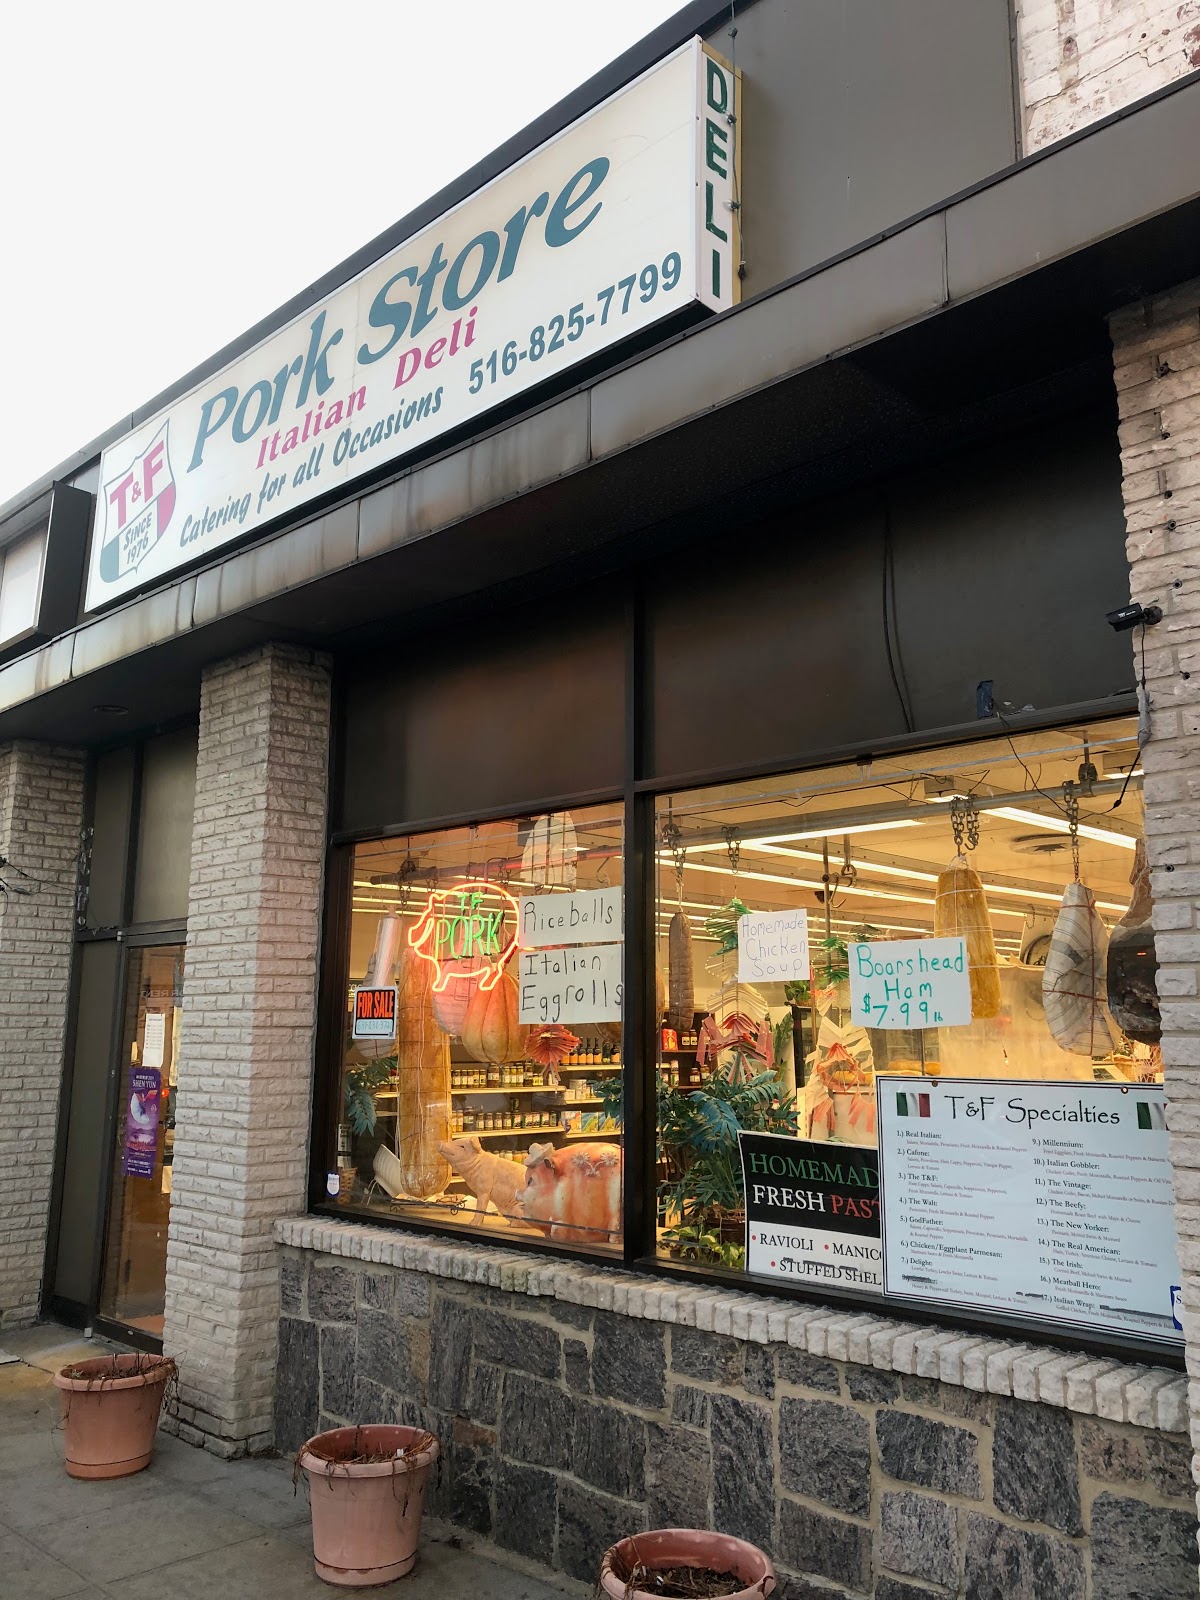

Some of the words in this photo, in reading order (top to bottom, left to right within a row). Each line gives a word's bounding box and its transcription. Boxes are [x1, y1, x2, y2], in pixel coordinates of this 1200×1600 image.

[706, 56, 728, 299] DELI
[187, 309, 343, 474] Pork
[357, 156, 610, 365] Store
[468, 251, 682, 395] 516-825-7799
[255, 385, 367, 470] Italian
[393, 306, 478, 391] Deli
[180, 492, 251, 547] Catering
[256, 472, 287, 514] for
[292, 442, 325, 488] all
[333, 386, 443, 466] Occasions
[110, 439, 165, 530] T&F
[123, 512, 152, 550] SINCE
[127, 530, 149, 564] 1976
[435, 911, 505, 960] PORK
[742, 914, 805, 938] Homemade
[524, 952, 602, 977] Italian
[751, 959, 803, 978] Soup
[522, 980, 623, 1023] Eggrolls
[884, 979, 932, 1001] Ham
[357, 991, 373, 1018] FOR
[374, 991, 394, 1018] SALE
[861, 993, 929, 1026] $7.99
[944, 1095, 995, 1120] T&F
[1005, 1098, 1120, 1130] Specialties
[1043, 1139, 1084, 1148] Millennium:
[749, 1152, 879, 1189] HOMEMAD
[1070, 1161, 1100, 1170] Gobbler:
[1064, 1180, 1091, 1190] Vintage:
[753, 1184, 826, 1213] FRESH
[830, 1194, 880, 1220] PAST
[1065, 1200, 1086, 1210] Beefy:
[1050, 1220, 1064, 1228] The
[1084, 1224, 1109, 1232] Yorker:
[760, 1233, 814, 1251] RAVIOLI
[832, 1243, 881, 1260] MANIC
[910, 1241, 967, 1253] Chicken/Eggplant
[969, 1248, 1002, 1258] Parmesan:
[1052, 1239, 1065, 1248] The
[1067, 1242, 1083, 1250] Real
[1084, 1244, 1120, 1255] American:
[779, 1259, 842, 1279] STUFFED
[845, 1267, 882, 1286] SHEL
[910, 1258, 932, 1266] Delight:
[1052, 1258, 1065, 1267] The
[1066, 1260, 1083, 1269] Irish:
[1053, 1277, 1081, 1287] Meatball
[1082, 1281, 1101, 1290] Hero:
[1054, 1296, 1074, 1306] Italian
